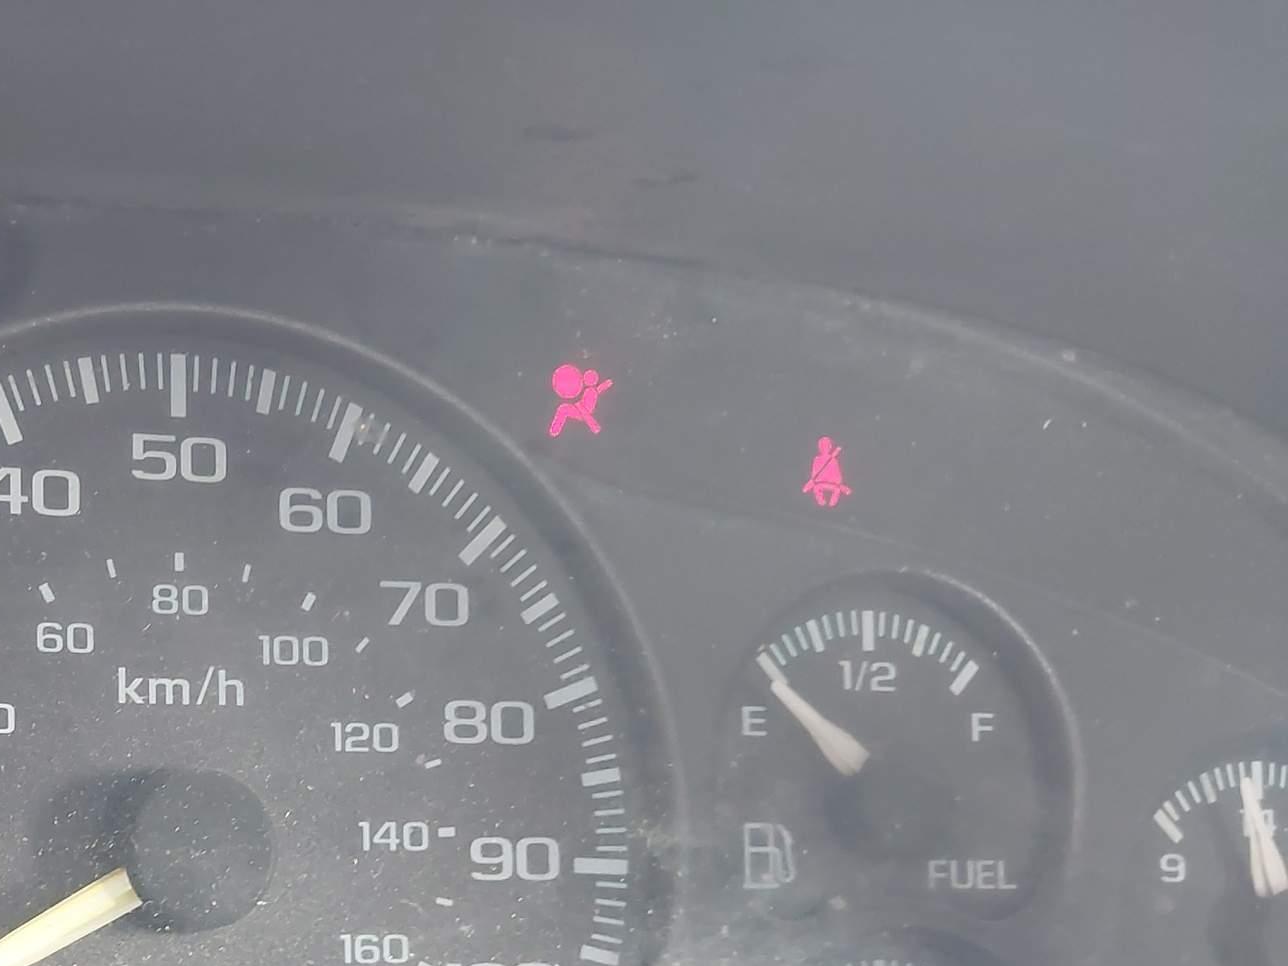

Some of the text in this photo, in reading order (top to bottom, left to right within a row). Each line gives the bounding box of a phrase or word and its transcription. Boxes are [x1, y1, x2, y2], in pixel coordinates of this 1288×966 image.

[130, 433, 228, 483] 50
[278, 487, 373, 535] 60
[151, 584, 210, 616] 80
[379, 580, 470, 627] 70
[35, 621, 95, 655] 60
[258, 634, 330, 666] 100
[117, 666, 245, 707] km/h
[838, 659, 898, 693] 1/2
[442, 699, 535, 746] 80
[740, 704, 768, 737] E
[970, 711, 996, 742] F
[330, 721, 400, 754] 120
[357, 820, 430, 852] 140
[469, 836, 561, 882] 90
[928, 858, 1018, 891] FUEL
[1159, 853, 1187, 882] 9
[339, 933, 410, 965] 160
